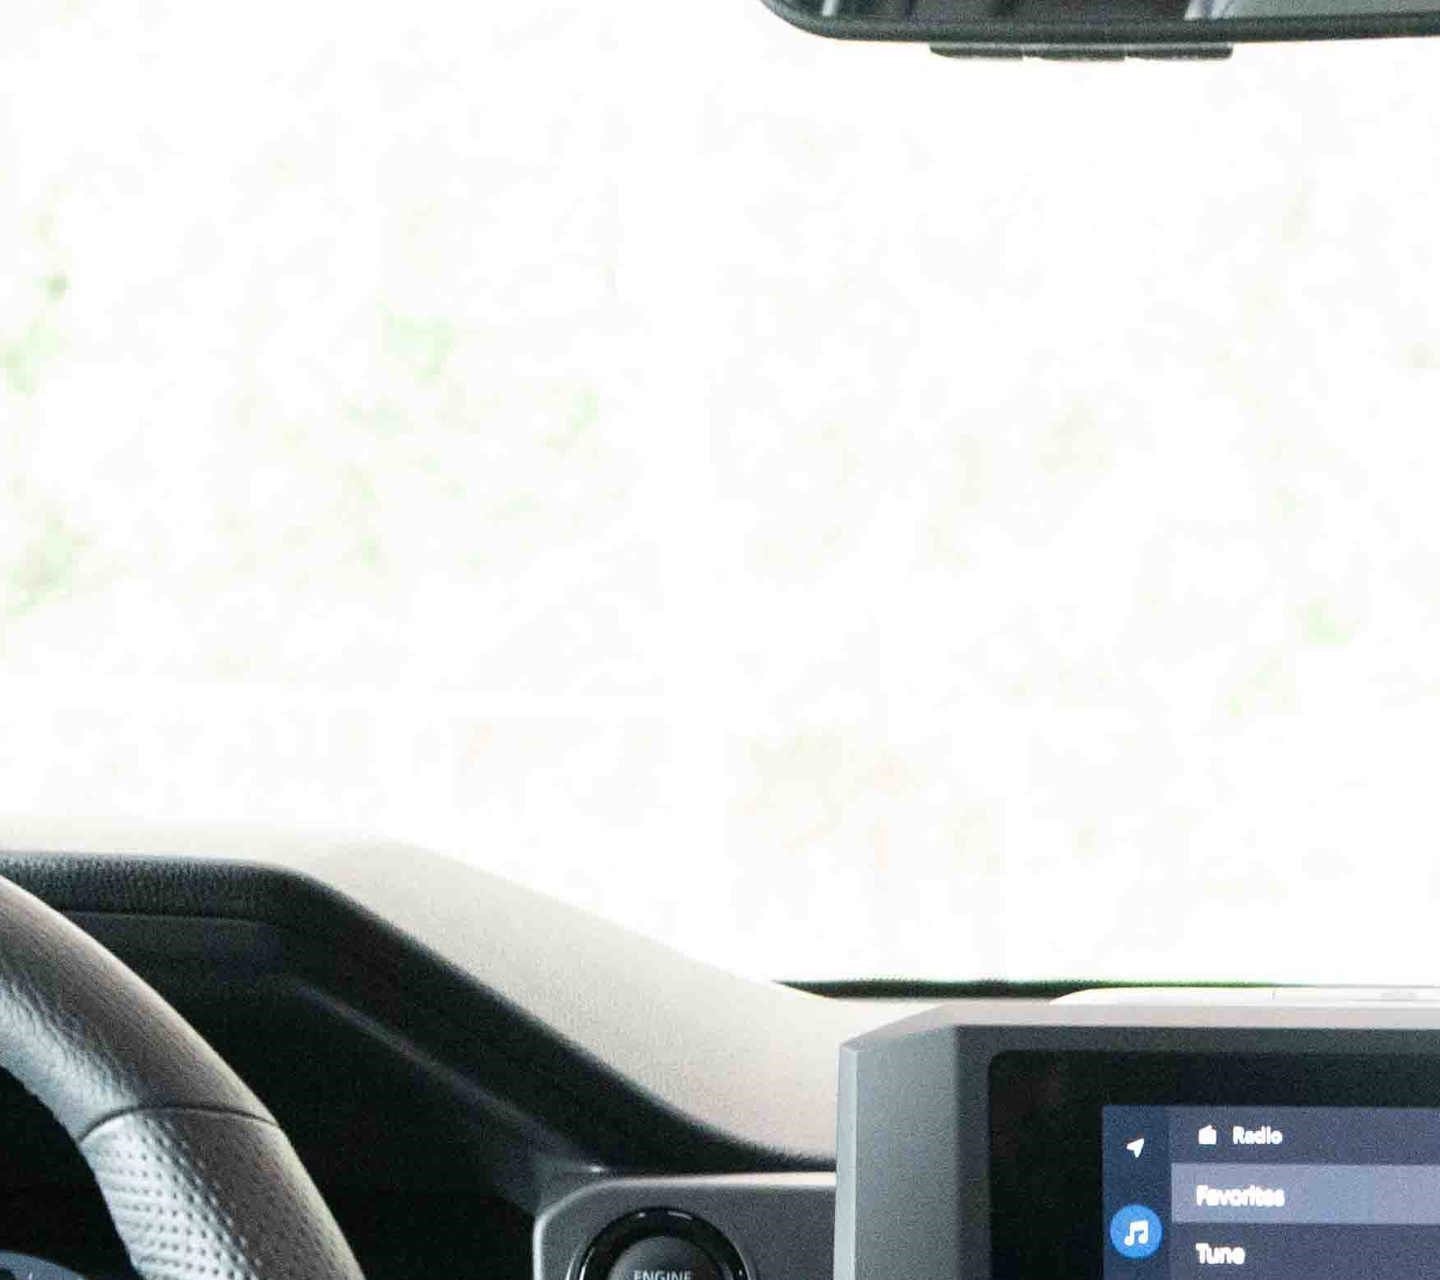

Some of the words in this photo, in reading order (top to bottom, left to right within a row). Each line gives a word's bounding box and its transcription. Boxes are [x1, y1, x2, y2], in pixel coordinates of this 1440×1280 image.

[1232, 1125, 1283, 1145] Radio
[1195, 1184, 1286, 1208] Favorites
[1195, 1242, 1247, 1266] Tune
